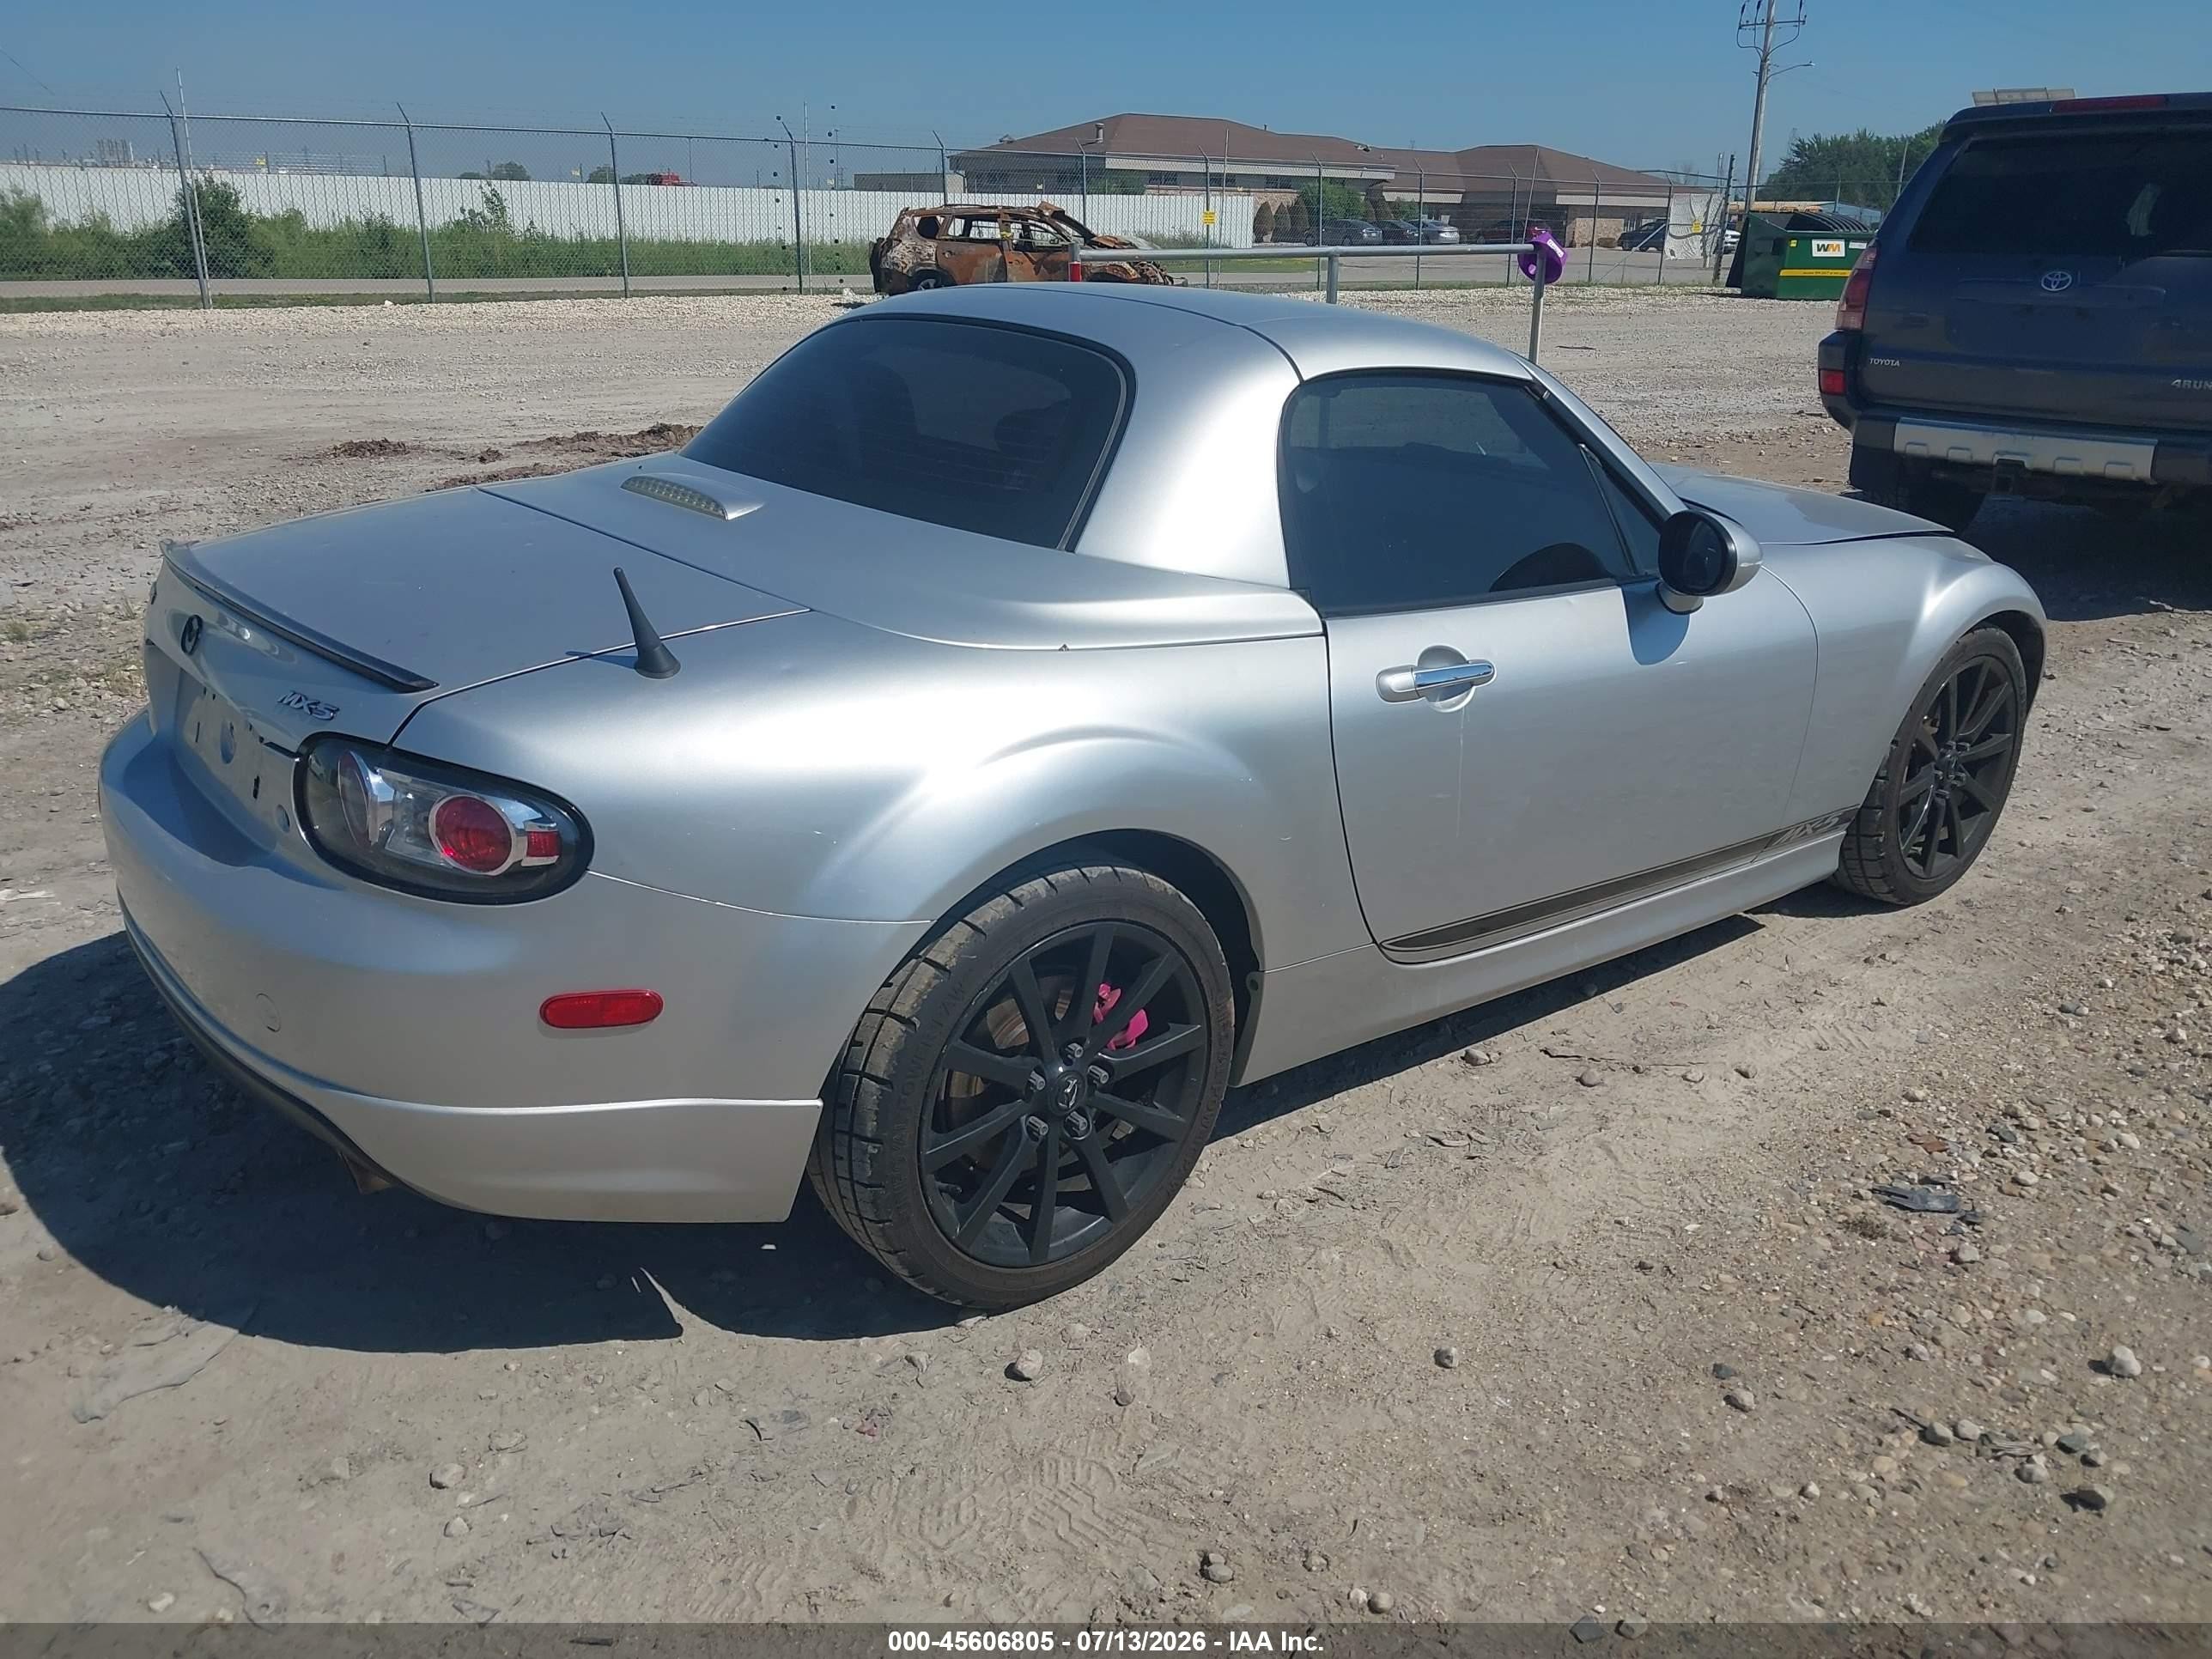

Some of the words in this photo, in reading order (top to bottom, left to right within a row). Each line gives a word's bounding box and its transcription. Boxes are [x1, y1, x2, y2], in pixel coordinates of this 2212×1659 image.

[1816, 243, 1840, 252] WM
[1869, 357, 1900, 367] TOYOTA
[277, 690, 340, 720] MX-5
